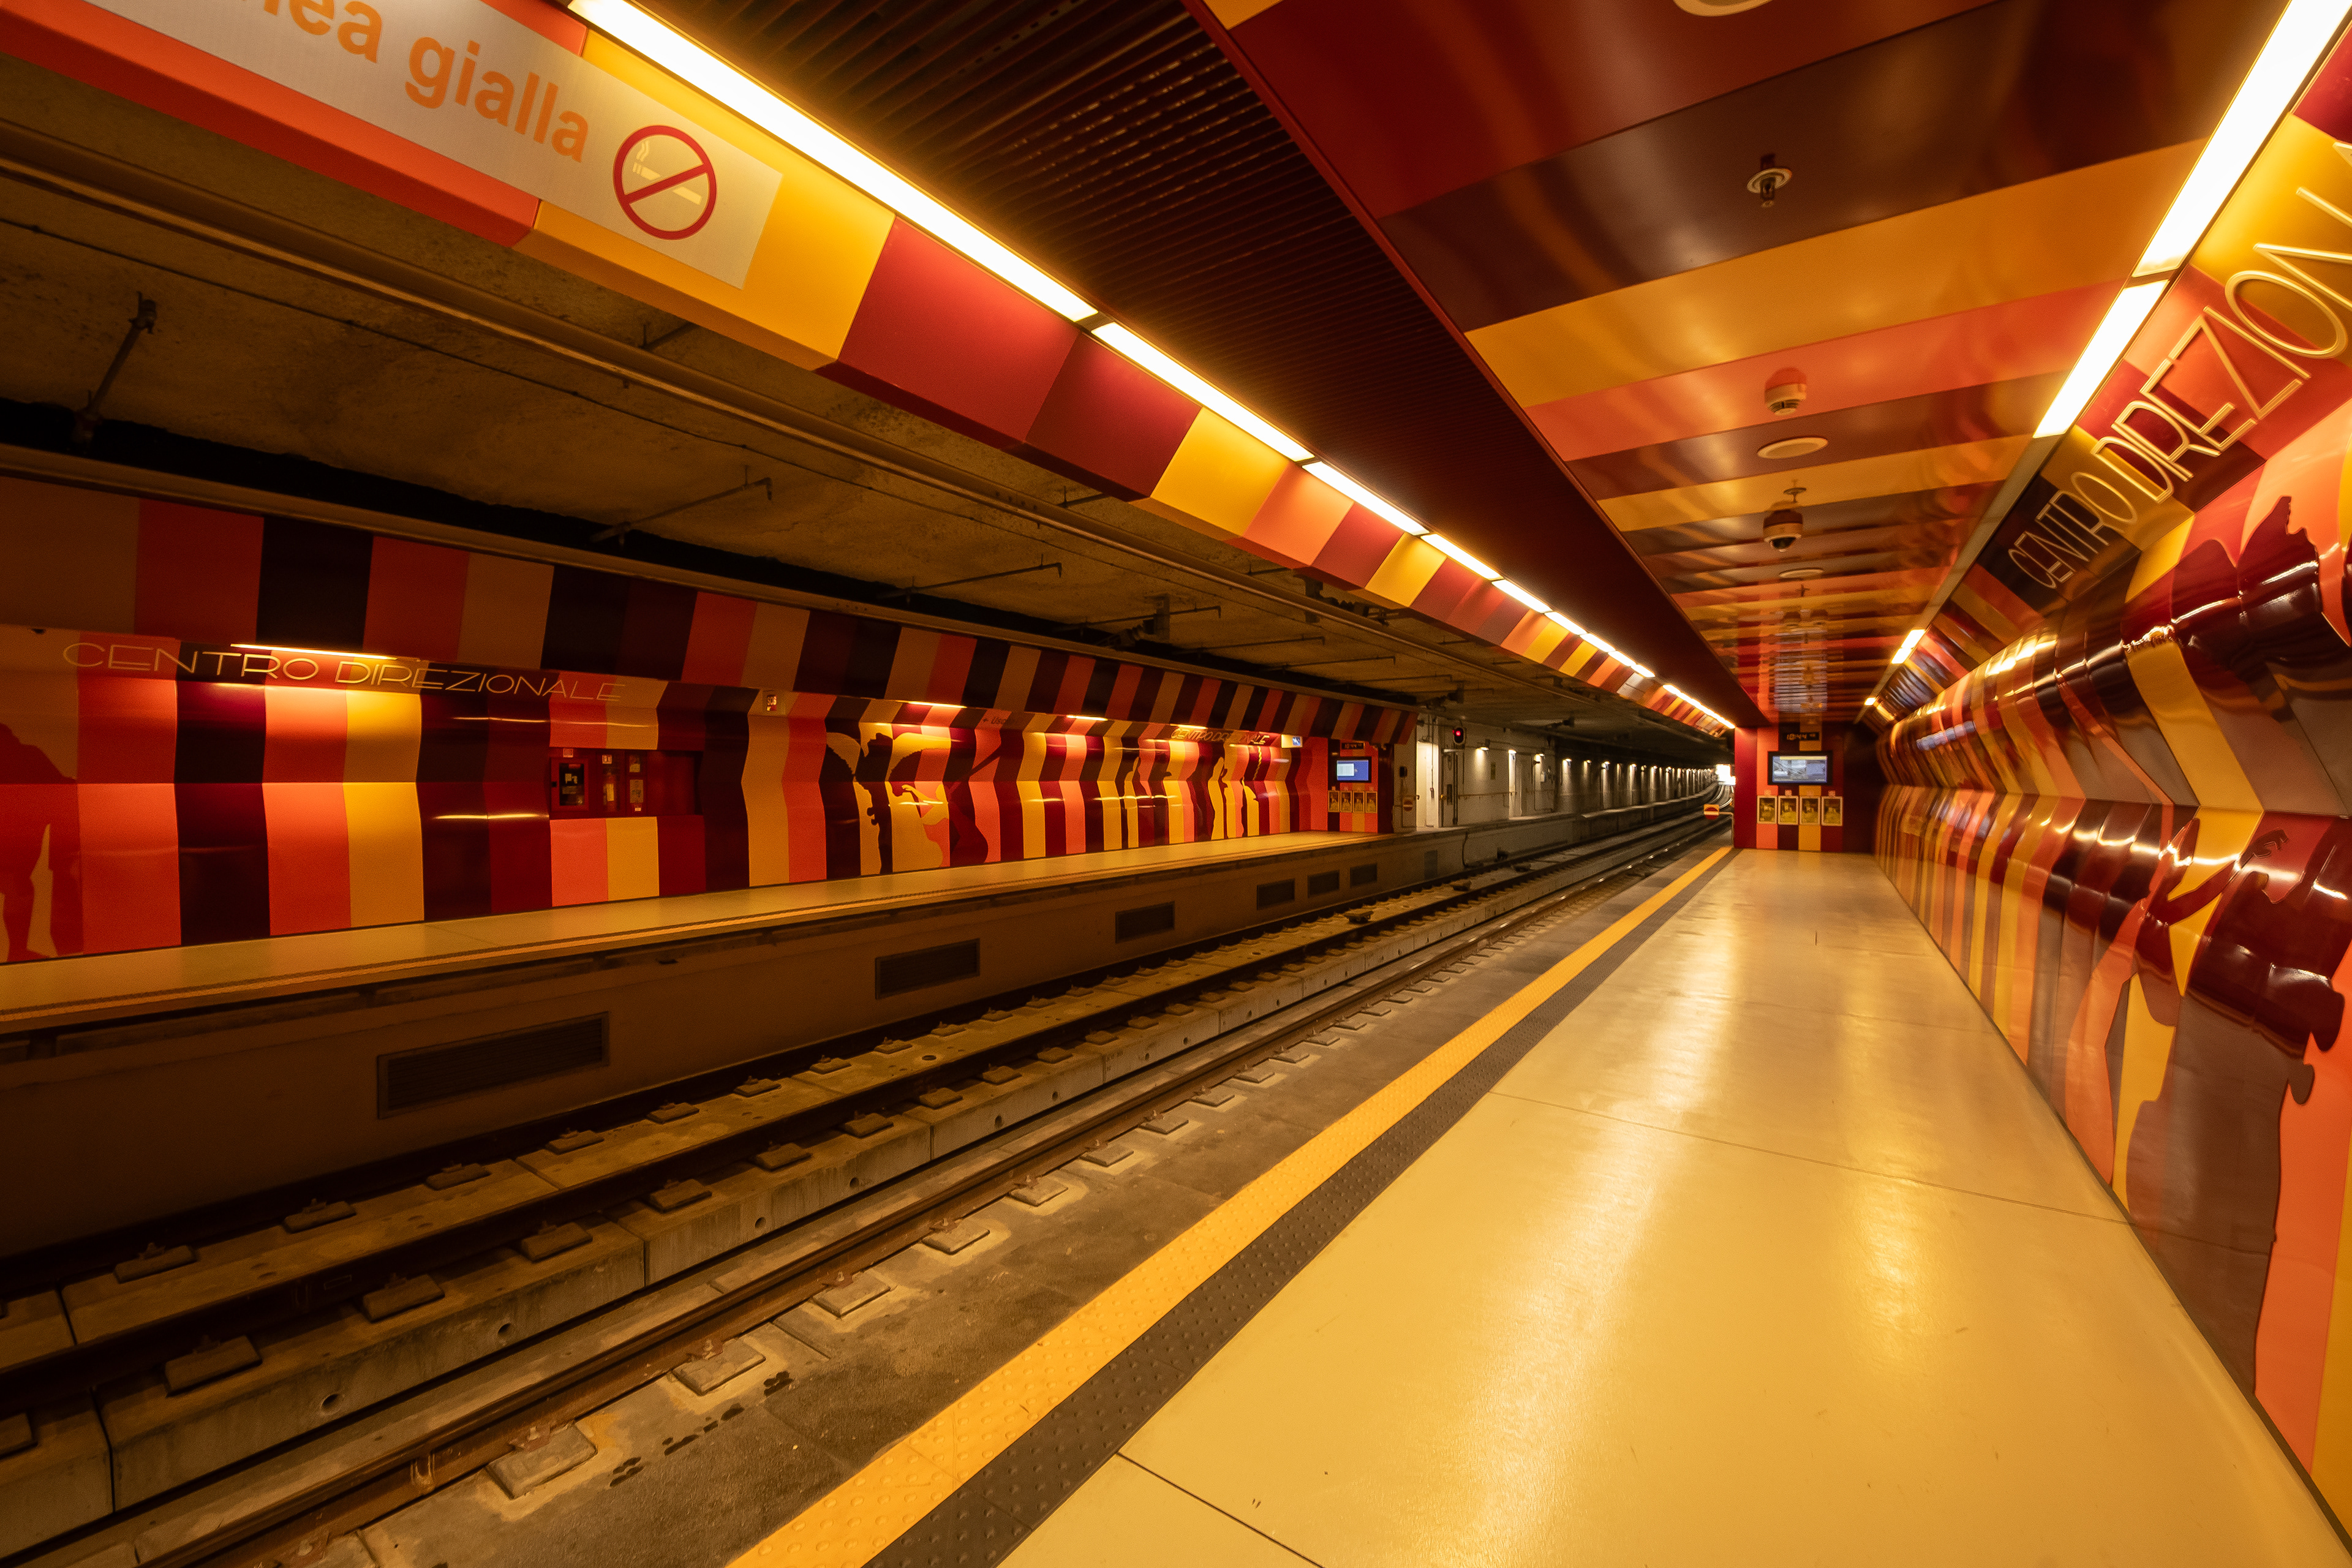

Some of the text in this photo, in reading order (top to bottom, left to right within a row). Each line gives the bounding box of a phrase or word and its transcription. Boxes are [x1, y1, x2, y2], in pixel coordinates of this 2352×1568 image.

[263, 0, 589, 164] ea gialla
[2008, 141, 2352, 589] CENTRO DIREZION
[62, 642, 627, 702] CENTRO DIREZIONALE
